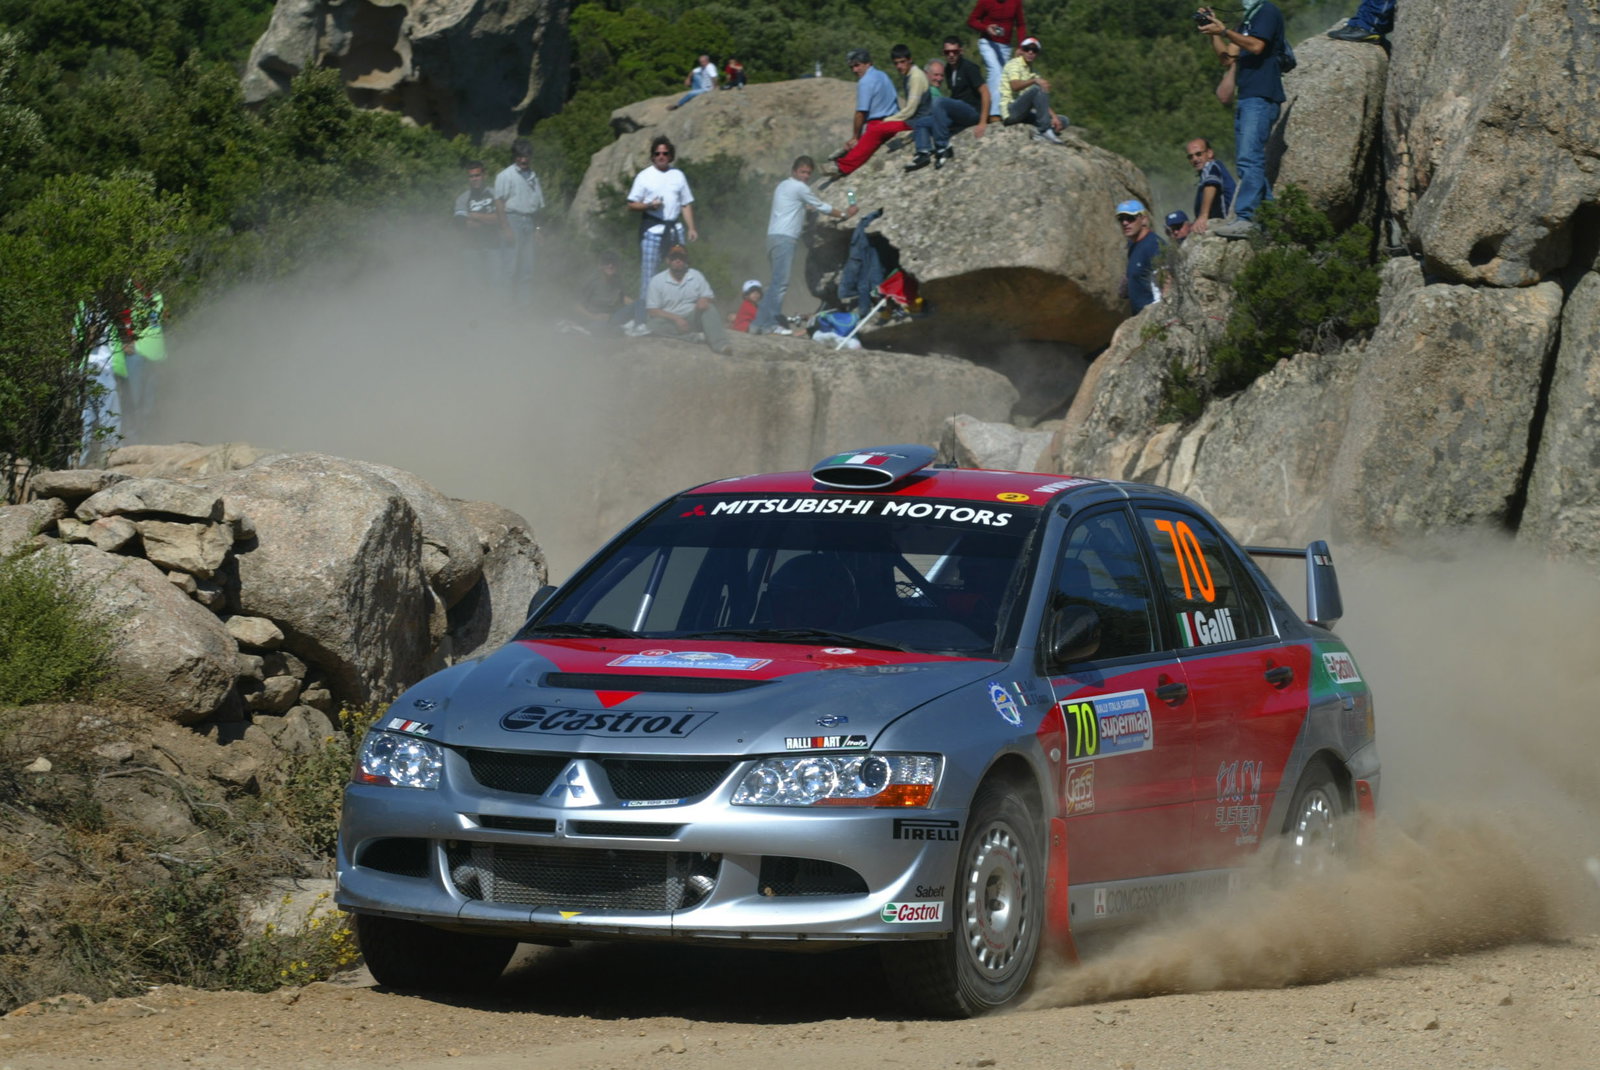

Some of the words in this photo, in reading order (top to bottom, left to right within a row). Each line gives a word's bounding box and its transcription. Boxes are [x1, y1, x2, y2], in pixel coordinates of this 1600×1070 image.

[710, 499, 874, 515] MITSUBISHI
[881, 501, 1013, 527] MOTORS
[1154, 519, 1216, 603] 70
[1194, 607, 1237, 645] Galli
[538, 709, 695, 735] Castrol
[1067, 702, 1096, 757] 70
[1101, 711, 1150, 744] supermag
[893, 818, 959, 841] PIRELLI
[898, 903, 941, 921] Castrol
